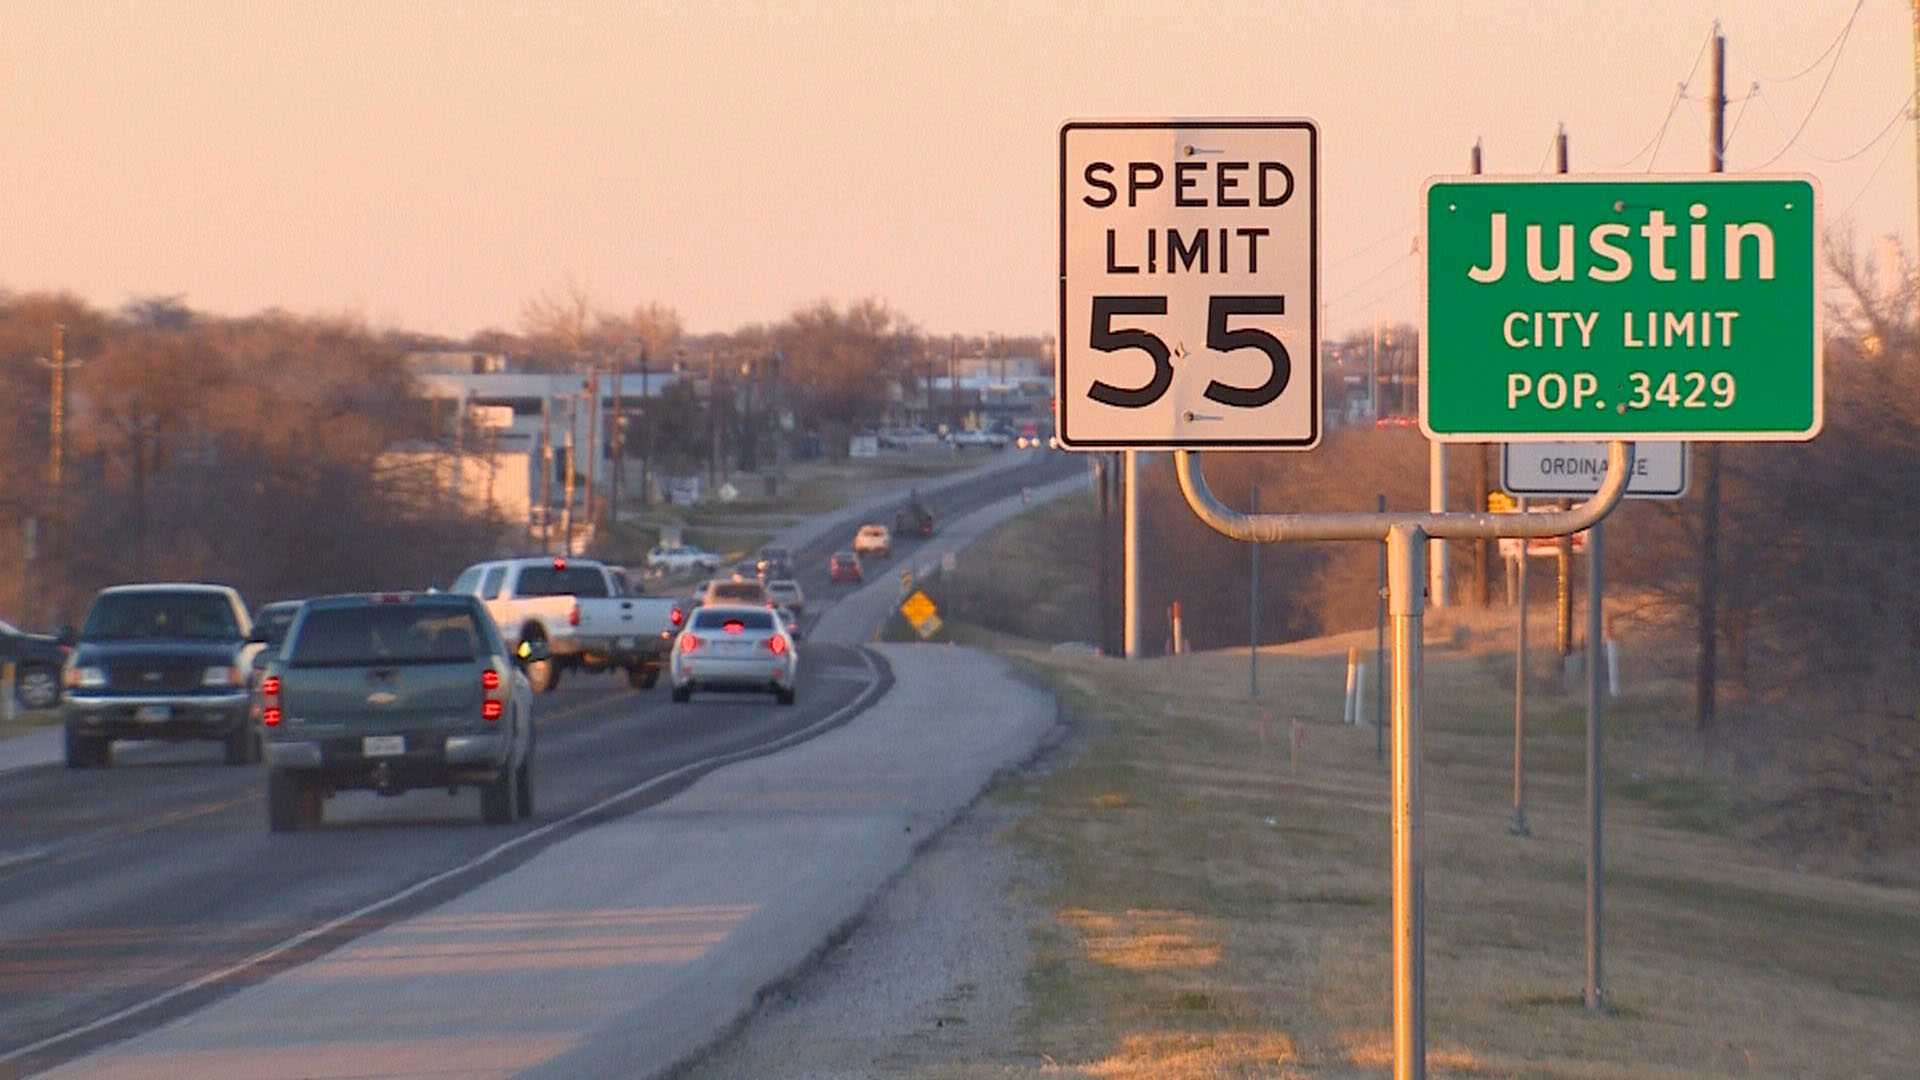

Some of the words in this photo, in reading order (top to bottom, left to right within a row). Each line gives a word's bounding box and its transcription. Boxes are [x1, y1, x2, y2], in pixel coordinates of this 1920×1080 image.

[1082, 161, 1295, 208] SPEED
[1106, 228, 1270, 274] LIMIT
[1467, 203, 1776, 284] Justin
[1086, 295, 1292, 409] 55
[1502, 311, 1600, 349] CITY
[1623, 311, 1740, 349] LIMIT
[1507, 371, 1606, 410] POP.
[1628, 370, 1736, 409] 3429
[1540, 457, 1648, 476] ORDINAE
